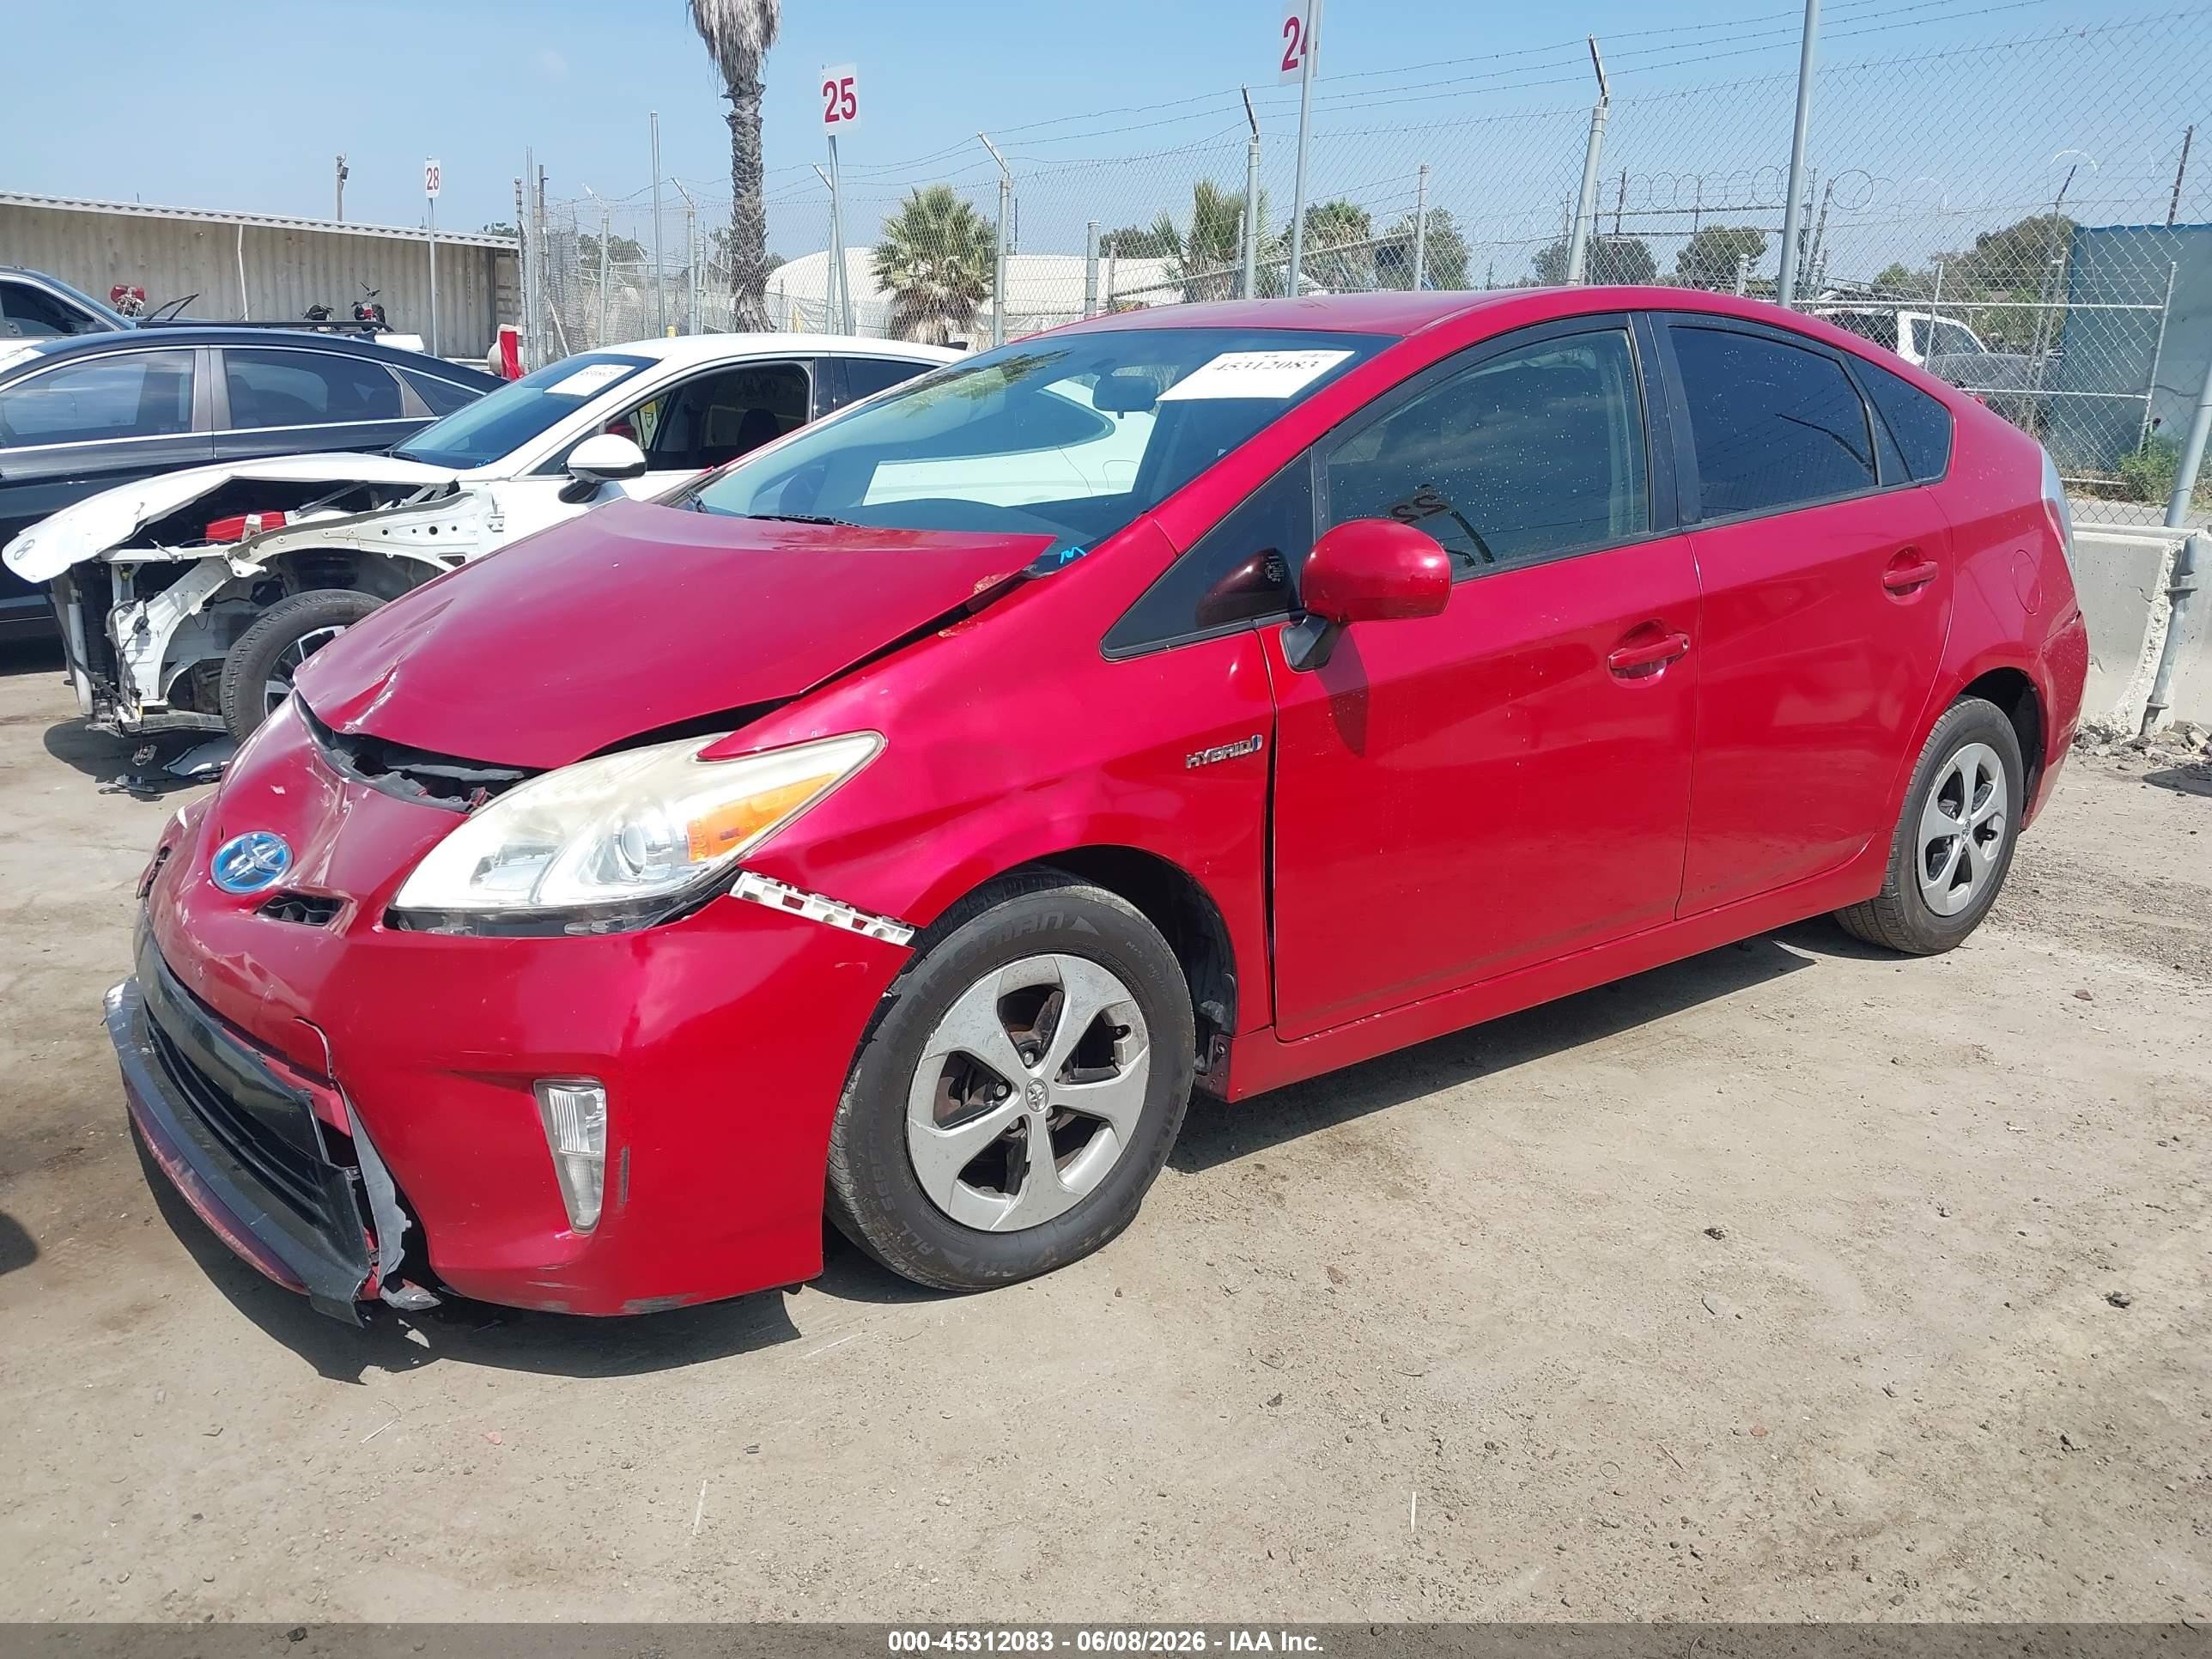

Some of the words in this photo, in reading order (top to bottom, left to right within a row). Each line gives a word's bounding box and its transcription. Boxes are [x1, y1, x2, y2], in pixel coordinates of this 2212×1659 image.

[823, 77, 857, 123] 25
[426, 167, 440, 191] 28
[1186, 739, 1253, 769] HYBRID
